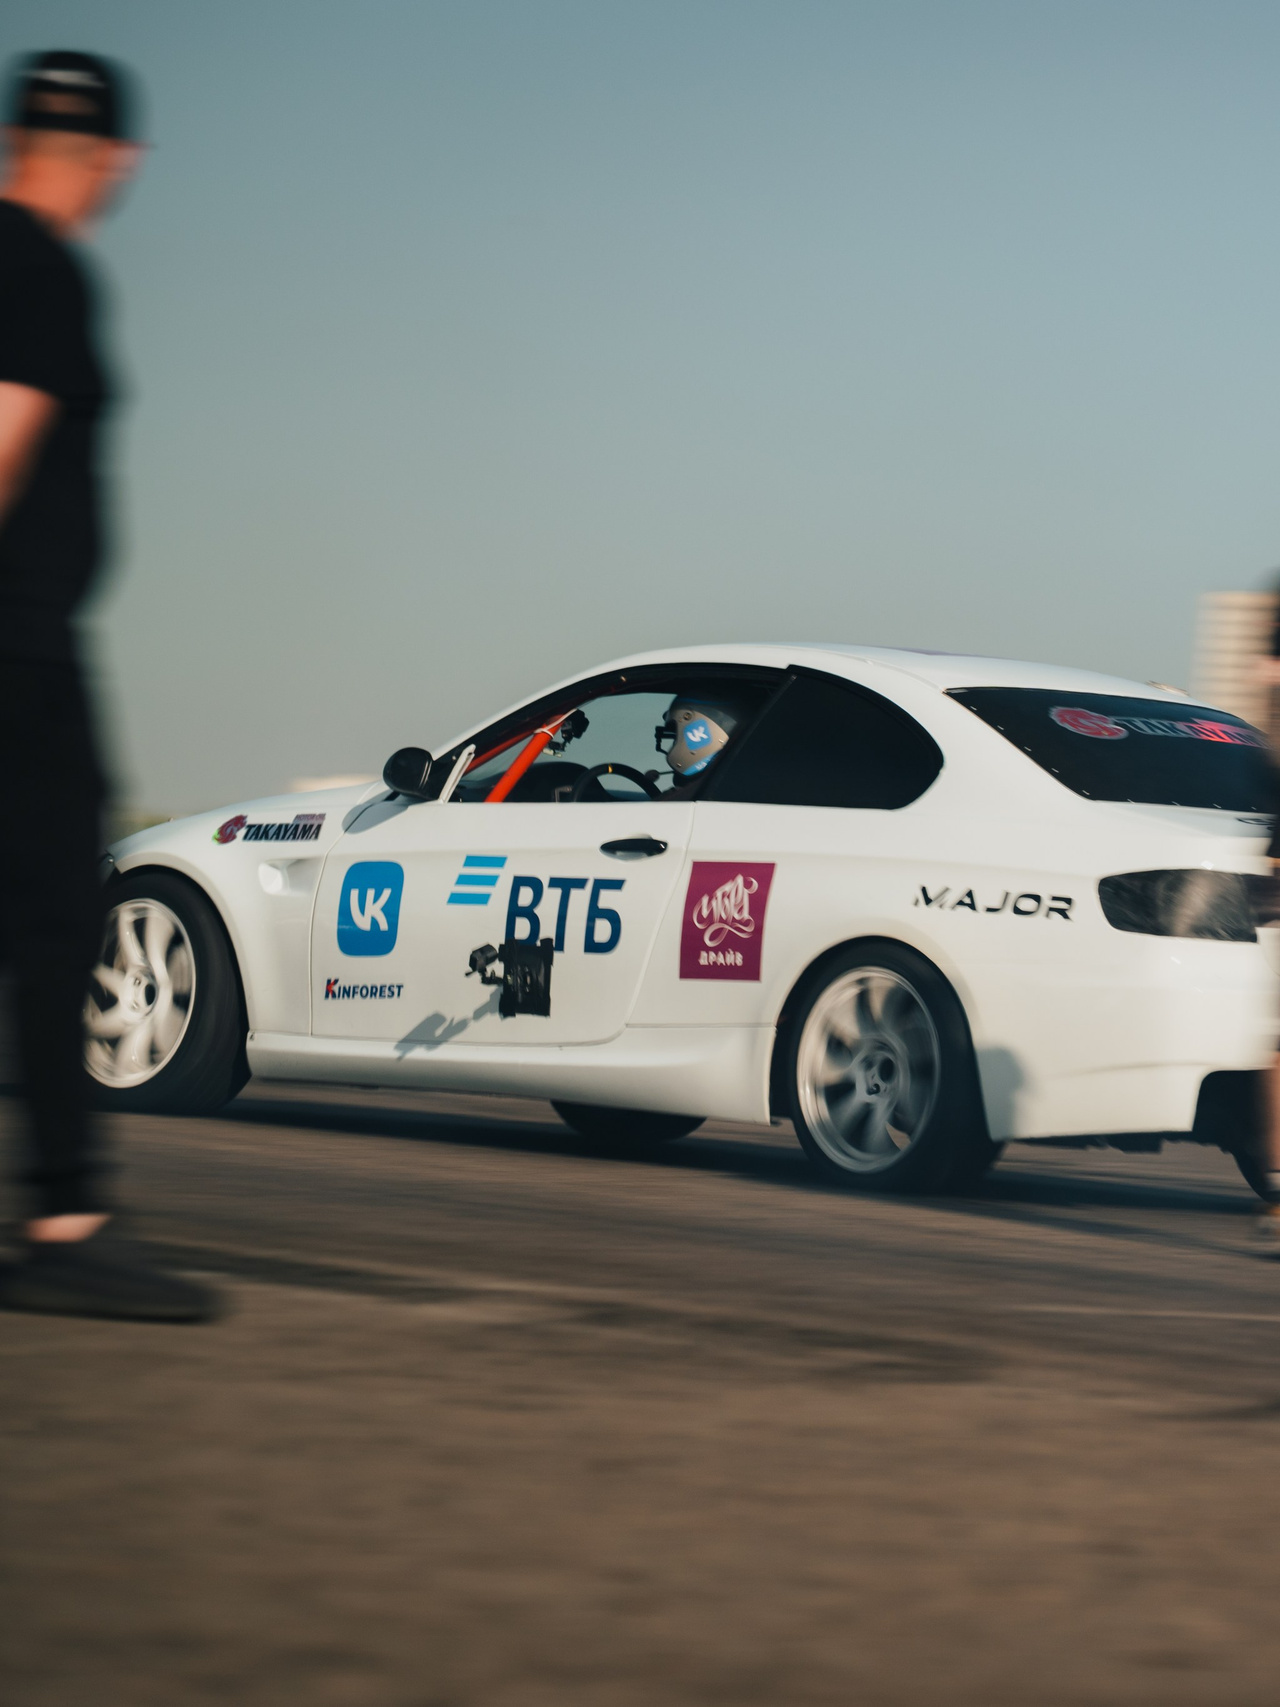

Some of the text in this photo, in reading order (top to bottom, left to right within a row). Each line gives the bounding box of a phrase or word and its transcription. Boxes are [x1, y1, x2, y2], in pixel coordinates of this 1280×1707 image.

[1112, 717, 1263, 747] TAKAYAM
[242, 823, 322, 841] TAKAYAMA
[350, 888, 392, 931] VK
[504, 875, 627, 955] ВТБ
[913, 885, 1073, 921] MAJOR
[698, 948, 744, 967] ДРАЙВ
